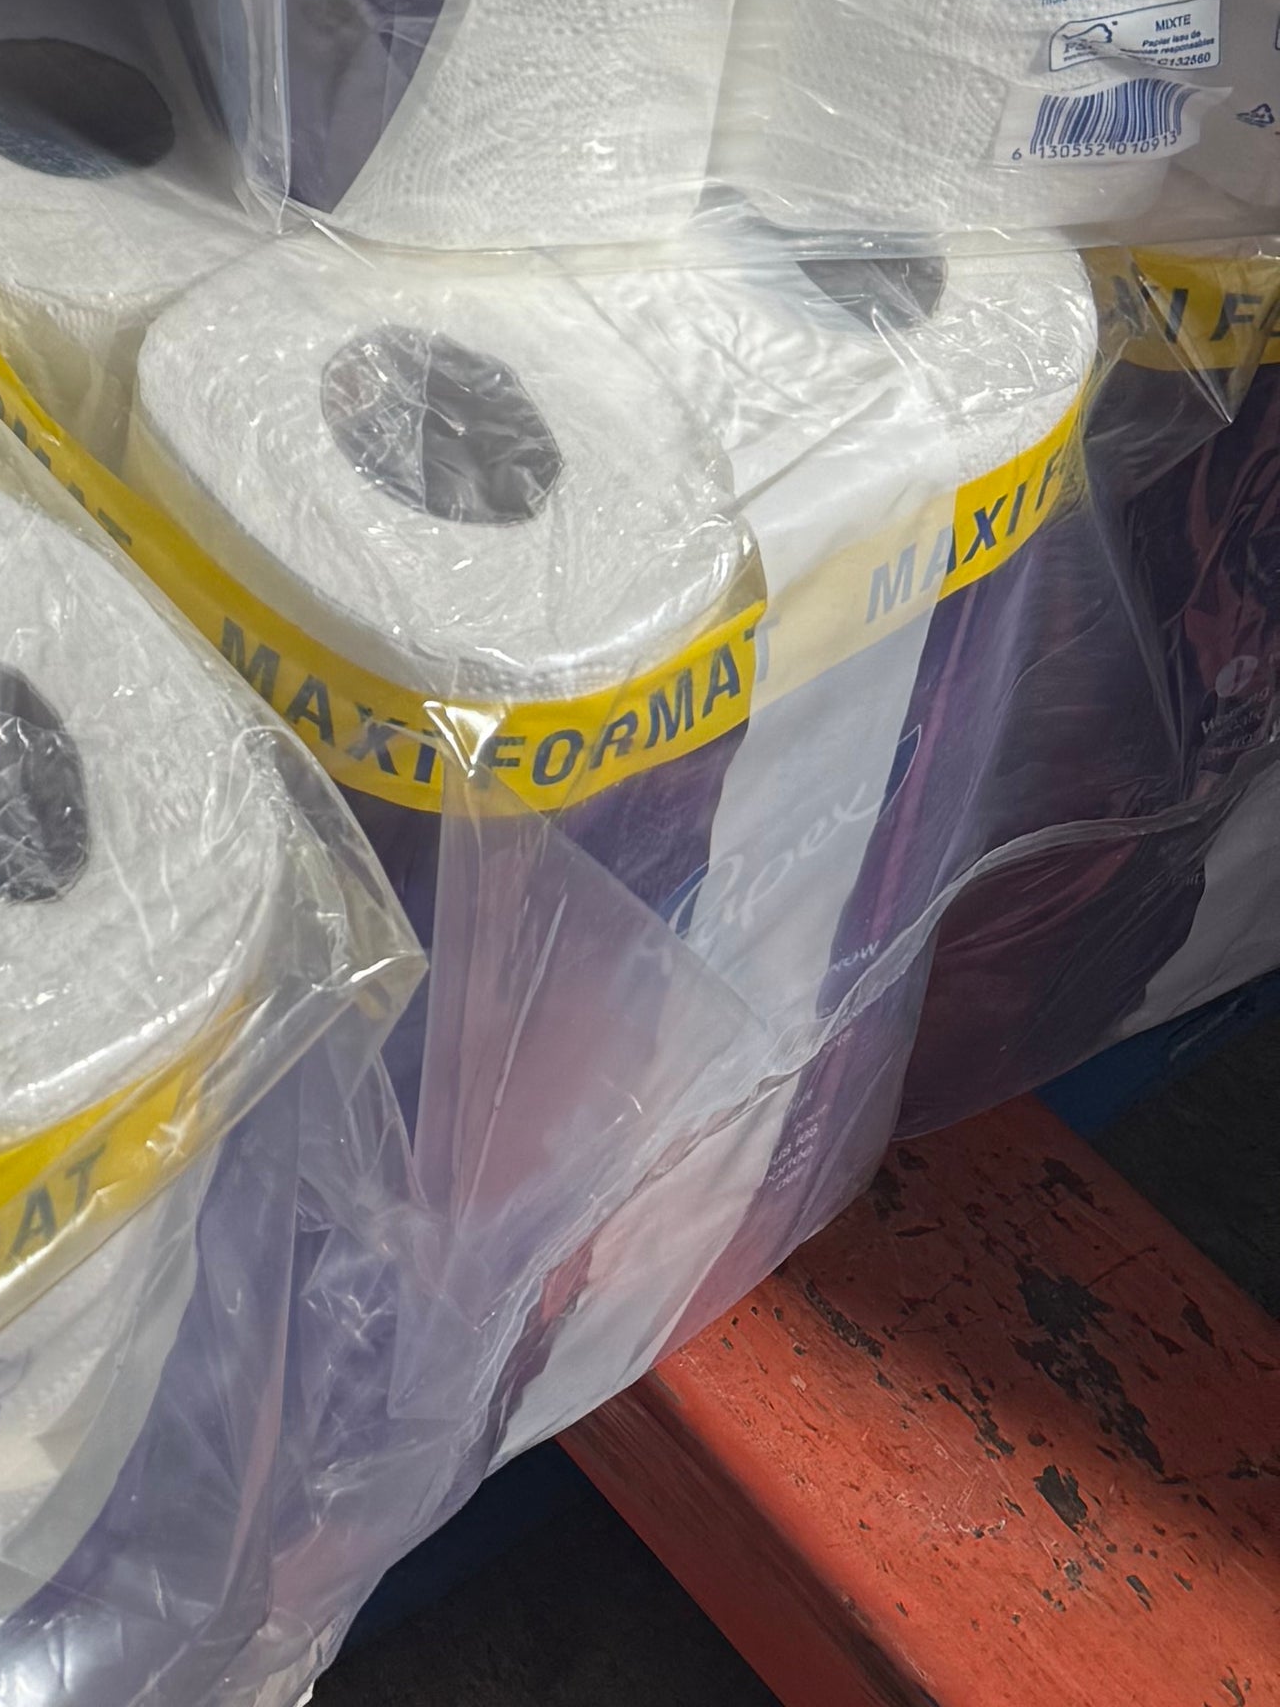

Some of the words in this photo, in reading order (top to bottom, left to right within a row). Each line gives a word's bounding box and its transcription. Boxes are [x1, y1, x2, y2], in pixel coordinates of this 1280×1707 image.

[1154, 13, 1192, 33] MIXTE
[1011, 147, 1023, 162] 6
[1039, 139, 1106, 160] 130552
[1115, 130, 1178, 156] 010913
[220, 616, 439, 785] MAXI
[480, 617, 782, 787] FORMAT
[866, 481, 1029, 625] MAXI
